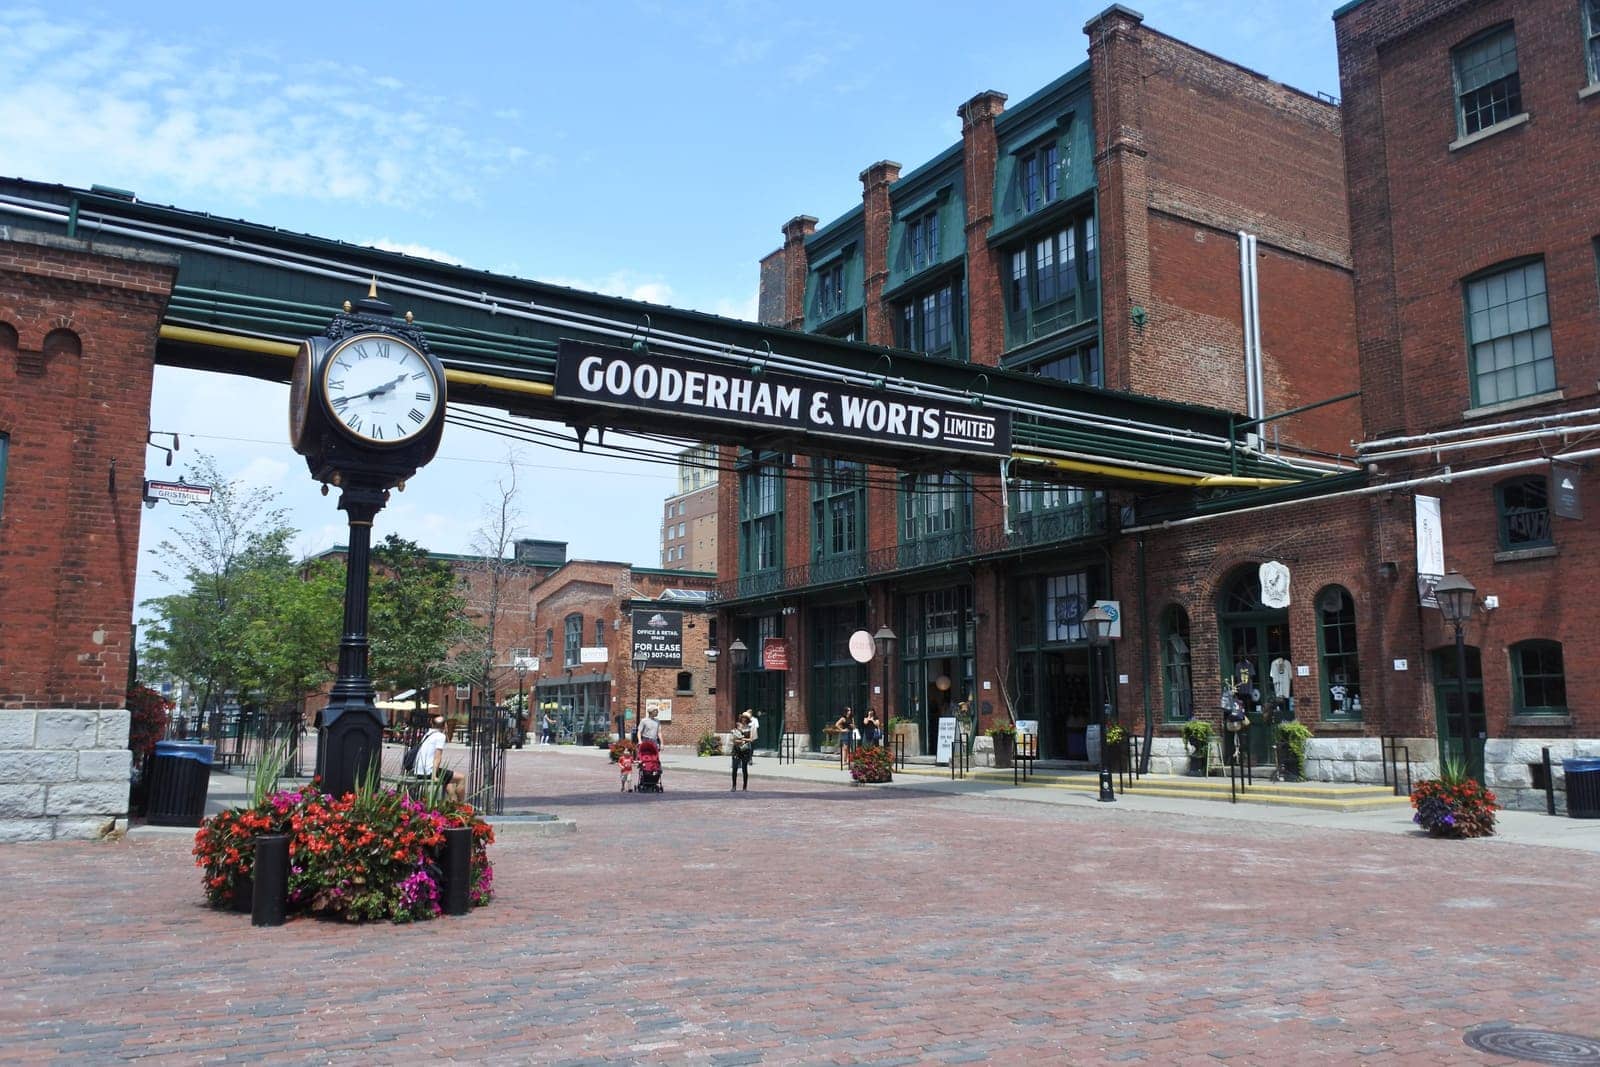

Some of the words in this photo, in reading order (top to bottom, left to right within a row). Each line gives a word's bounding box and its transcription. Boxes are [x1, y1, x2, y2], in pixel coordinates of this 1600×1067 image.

[577, 355, 801, 420] GOODERHAM
[809, 390, 834, 426] &
[840, 394, 941, 439] WORTS
[943, 416, 996, 441] LIMITED
[158, 490, 200, 500] GRISTMILL
